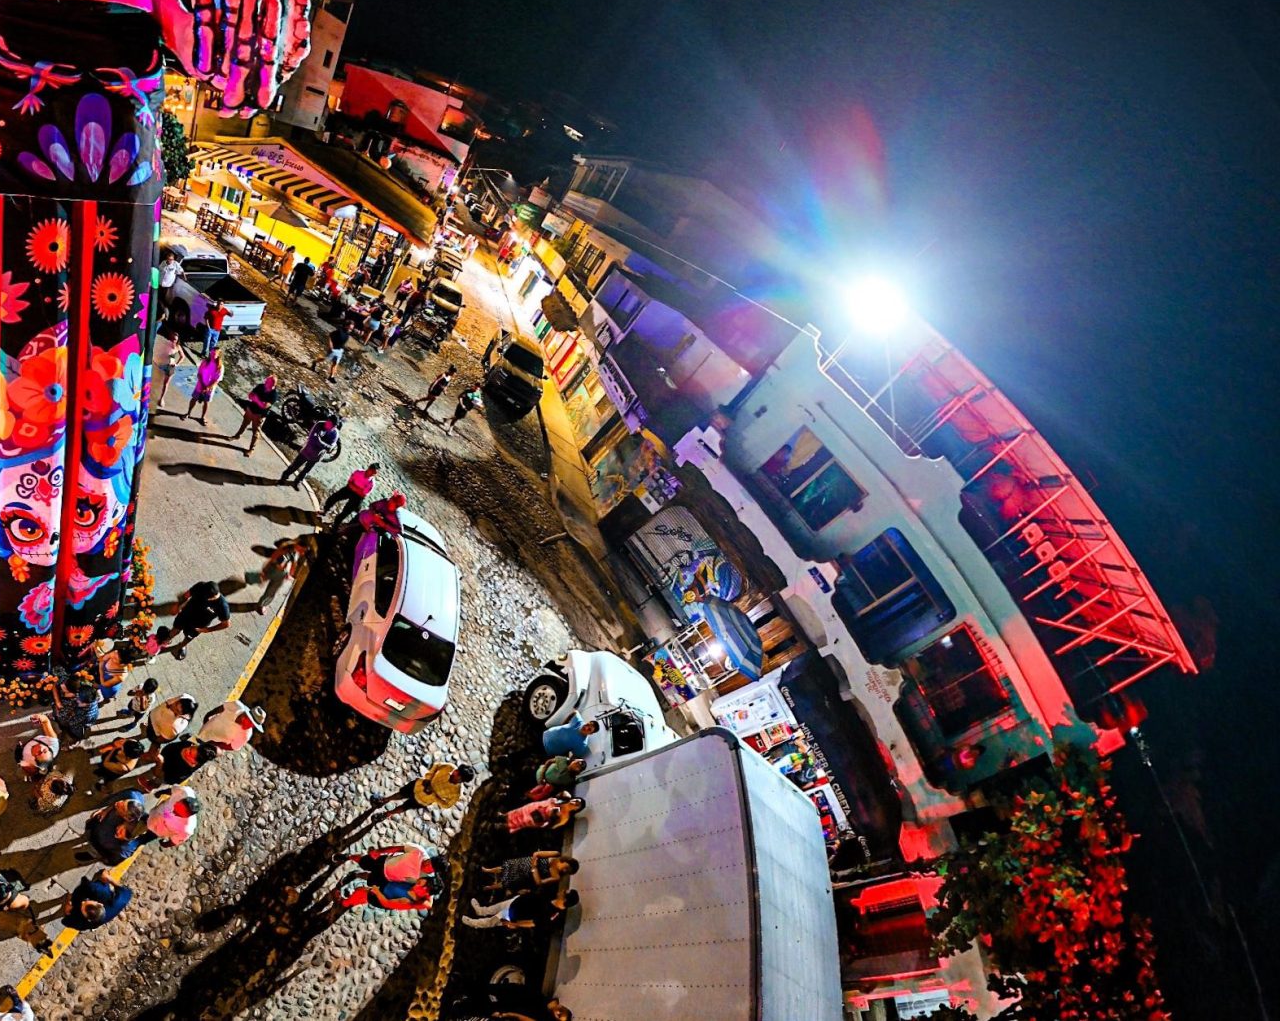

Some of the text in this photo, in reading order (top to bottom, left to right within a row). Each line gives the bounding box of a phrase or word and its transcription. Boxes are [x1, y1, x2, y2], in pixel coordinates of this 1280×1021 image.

[800, 722, 852, 816] MINI SUPER LA CUBETA
